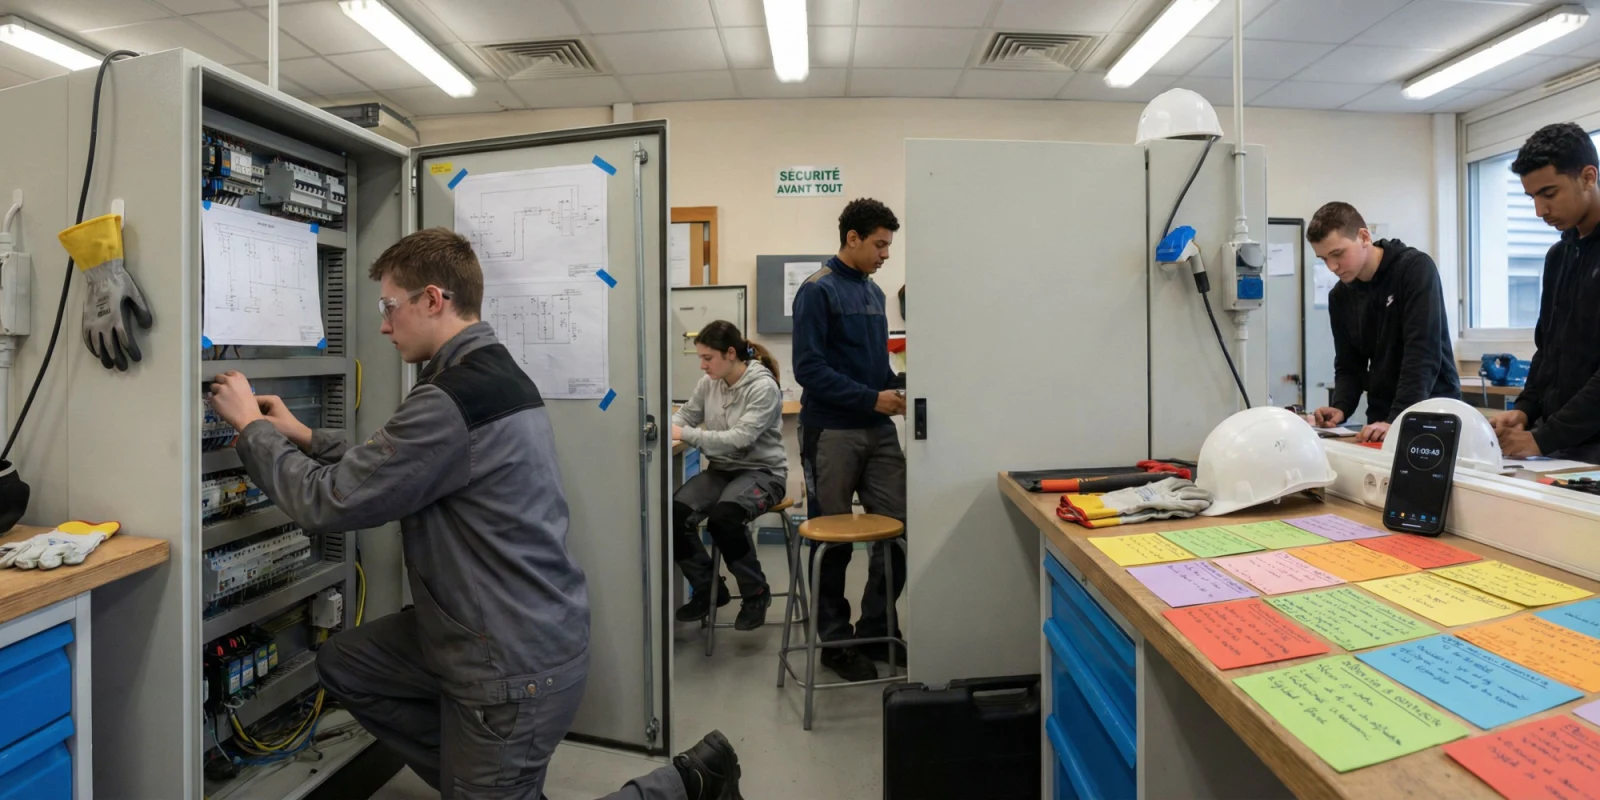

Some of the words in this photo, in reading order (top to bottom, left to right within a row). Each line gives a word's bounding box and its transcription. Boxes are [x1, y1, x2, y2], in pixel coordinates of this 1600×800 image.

[780, 167, 840, 181] SÉCURITÉ
[777, 184, 812, 194] AVANT
[815, 183, 843, 193] TOUT
